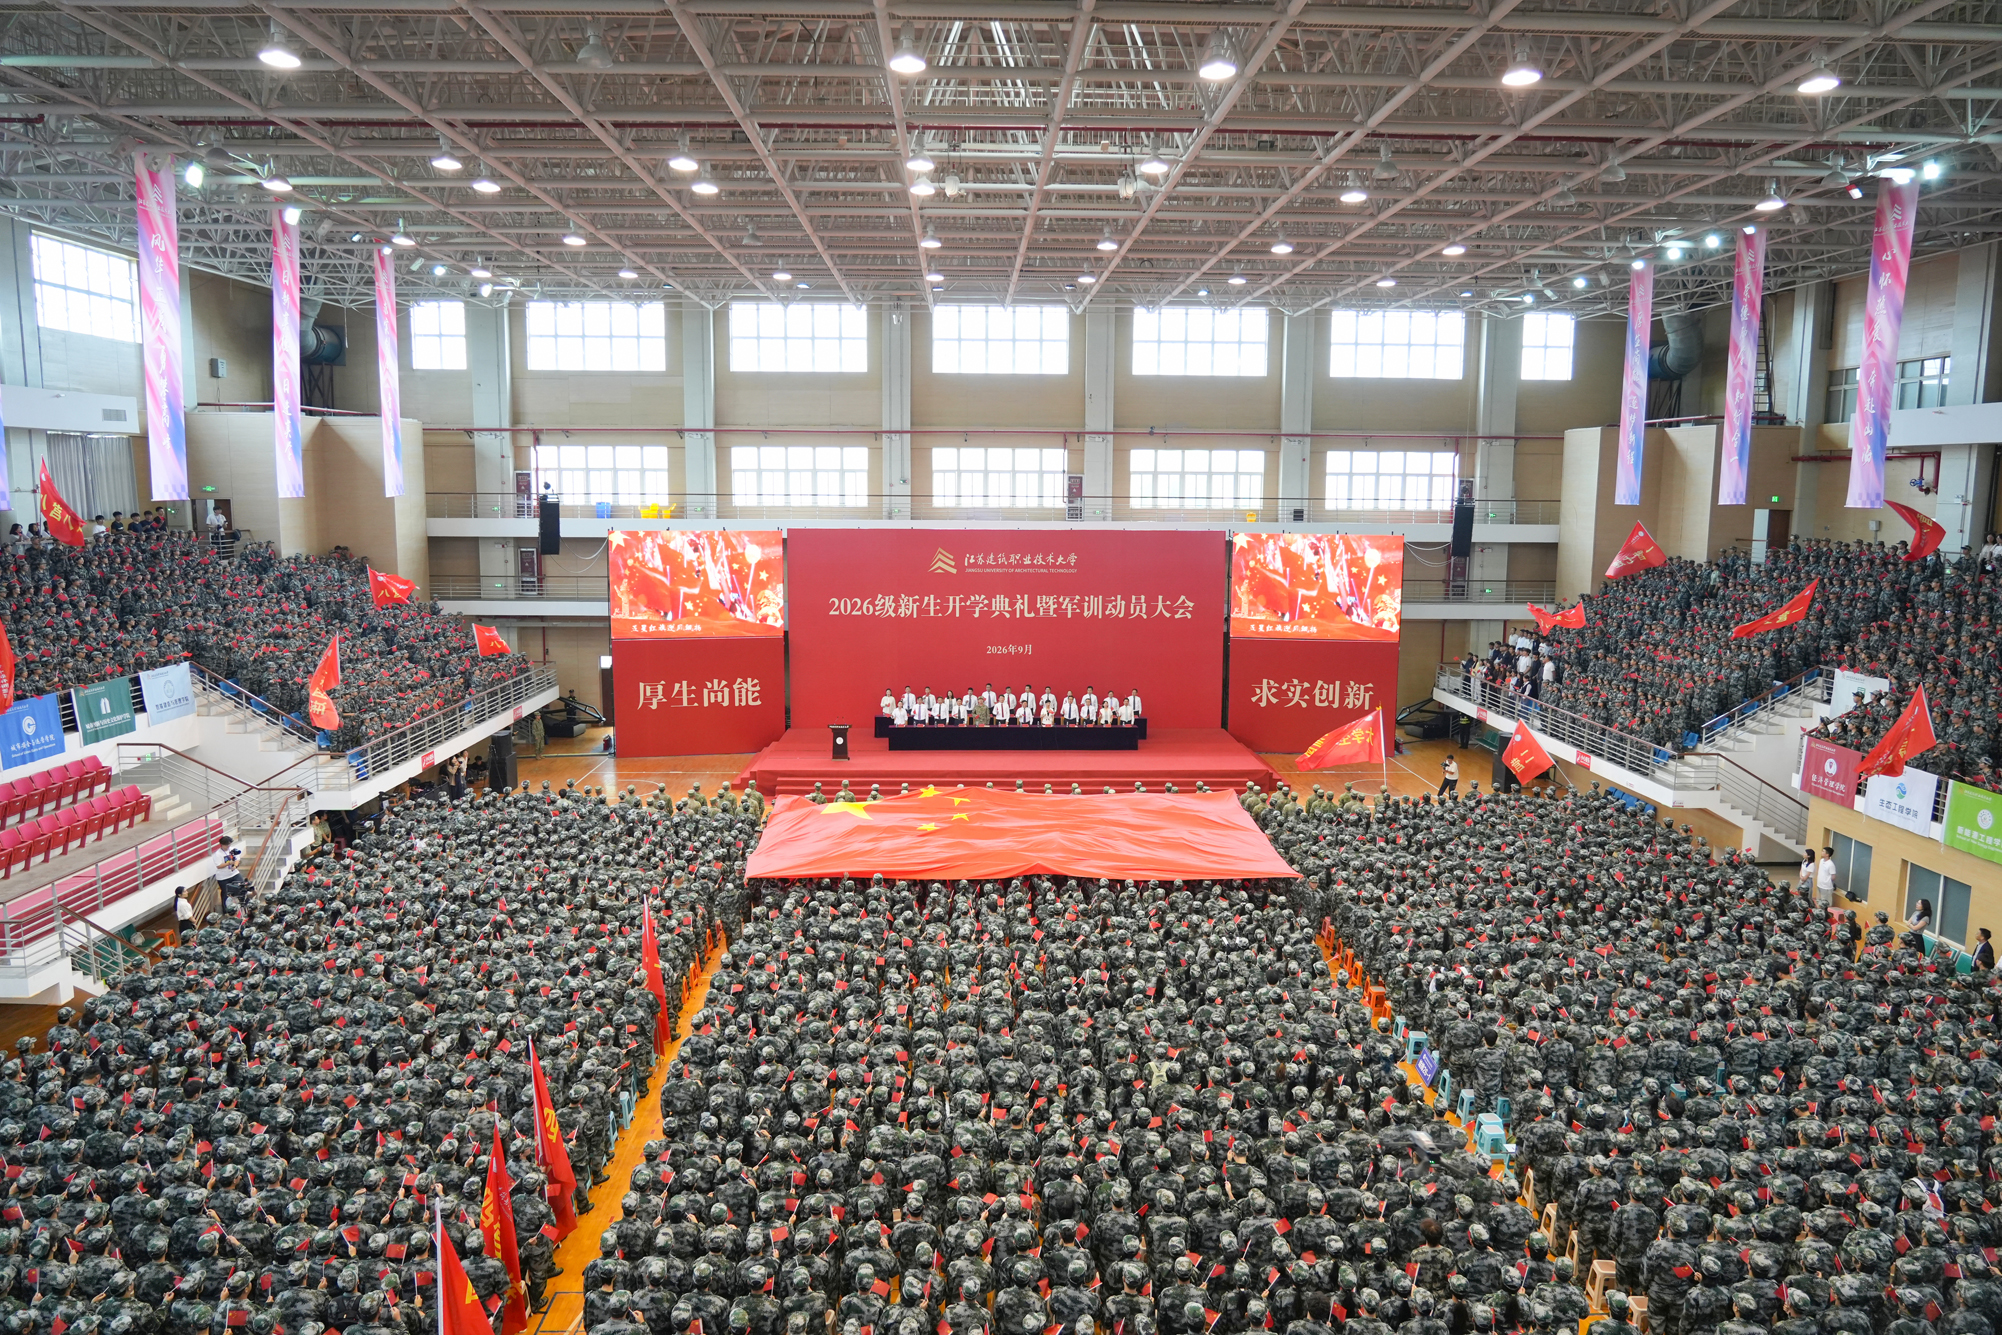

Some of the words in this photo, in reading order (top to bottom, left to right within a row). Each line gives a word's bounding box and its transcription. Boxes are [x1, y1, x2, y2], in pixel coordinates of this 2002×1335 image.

[1873, 248, 1897, 343] 心怀热爱
[1861, 367, 1876, 466] 奔赴山海
[964, 552, 1078, 567] 江苏建筑职业技术大学
[828, 593, 1195, 620] 2026级新生开学典礼暨军训动员大会
[631, 623, 702, 633] 五星红旗迎风飘扬
[1248, 624, 1317, 634] 五星红旗迎风飘扬
[986, 644, 1032, 655] 2026年9月
[636, 677, 762, 710] 厚生尚能
[1250, 678, 1374, 711] 求实创新
[1811, 774, 1846, 792] 经济管理学院
[1879, 798, 1919, 819] 生态工程学院
[1957, 825, 2002, 848] 新能源工程学
